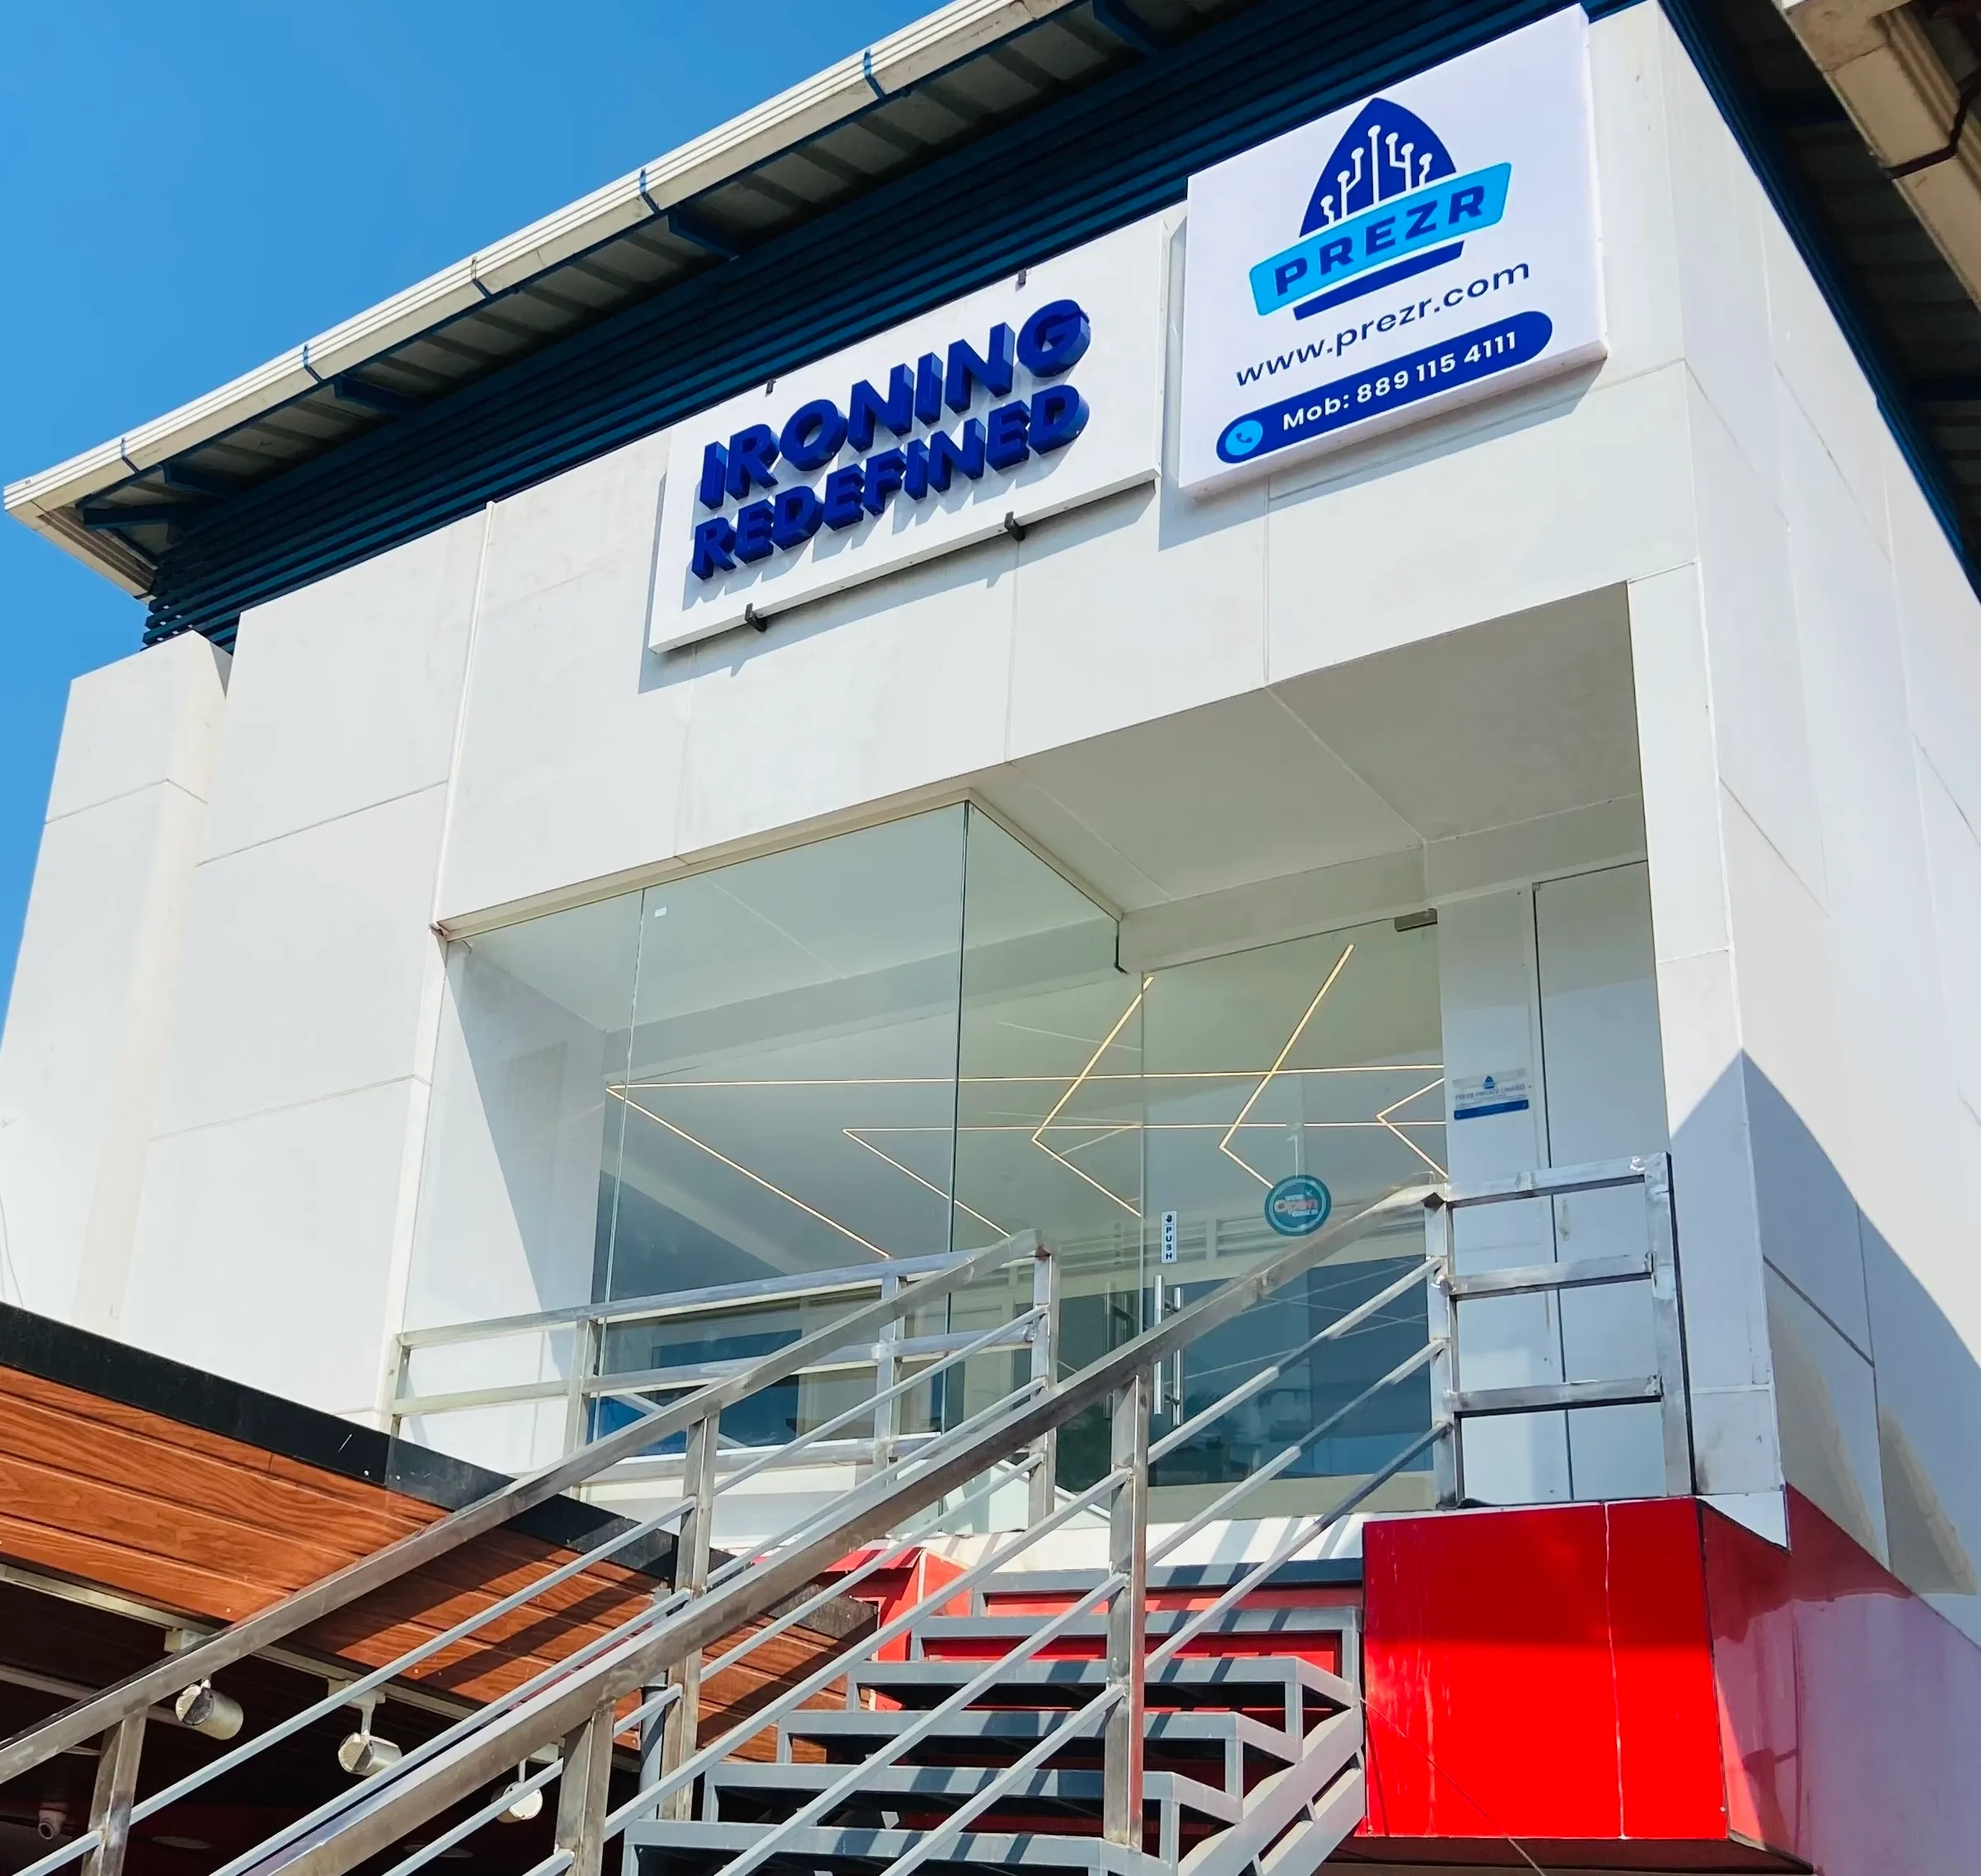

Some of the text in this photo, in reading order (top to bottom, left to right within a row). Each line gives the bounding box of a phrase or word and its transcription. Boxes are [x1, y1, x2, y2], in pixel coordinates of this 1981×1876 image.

[1274, 185, 1485, 297] PREZR
[1236, 262, 1530, 386] www.prezr.com
[1283, 330, 1517, 430] Mob: 889 115 4111
[699, 299, 1091, 510] IRONING
[692, 385, 1089, 580] REDEFINED
[1165, 1226, 1173, 1260] PUSH
